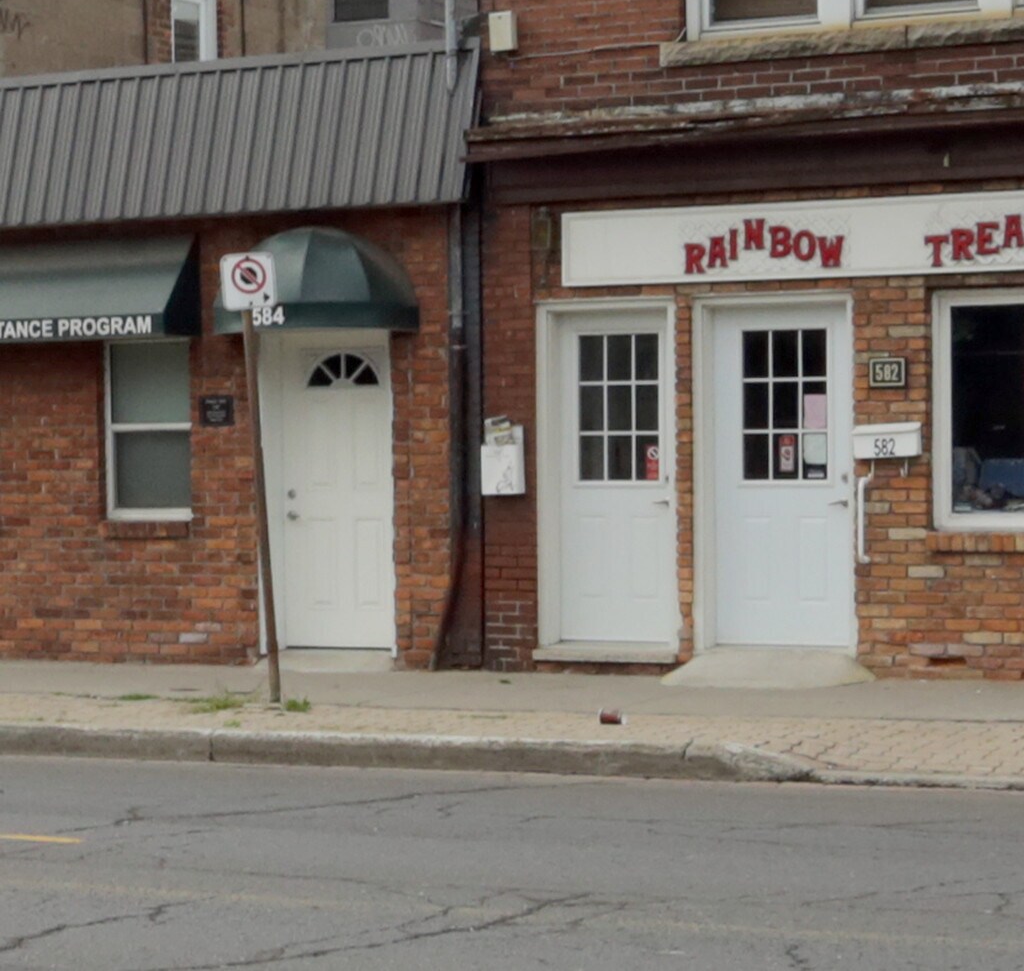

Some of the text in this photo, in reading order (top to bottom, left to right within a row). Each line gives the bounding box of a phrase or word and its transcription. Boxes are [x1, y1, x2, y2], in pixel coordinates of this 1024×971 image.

[684, 218, 845, 274] RAINBOW
[57, 315, 152, 337] PROGRAM
[252, 306, 286, 326] 584
[875, 363, 899, 382] 582
[873, 437, 896, 457] 582
